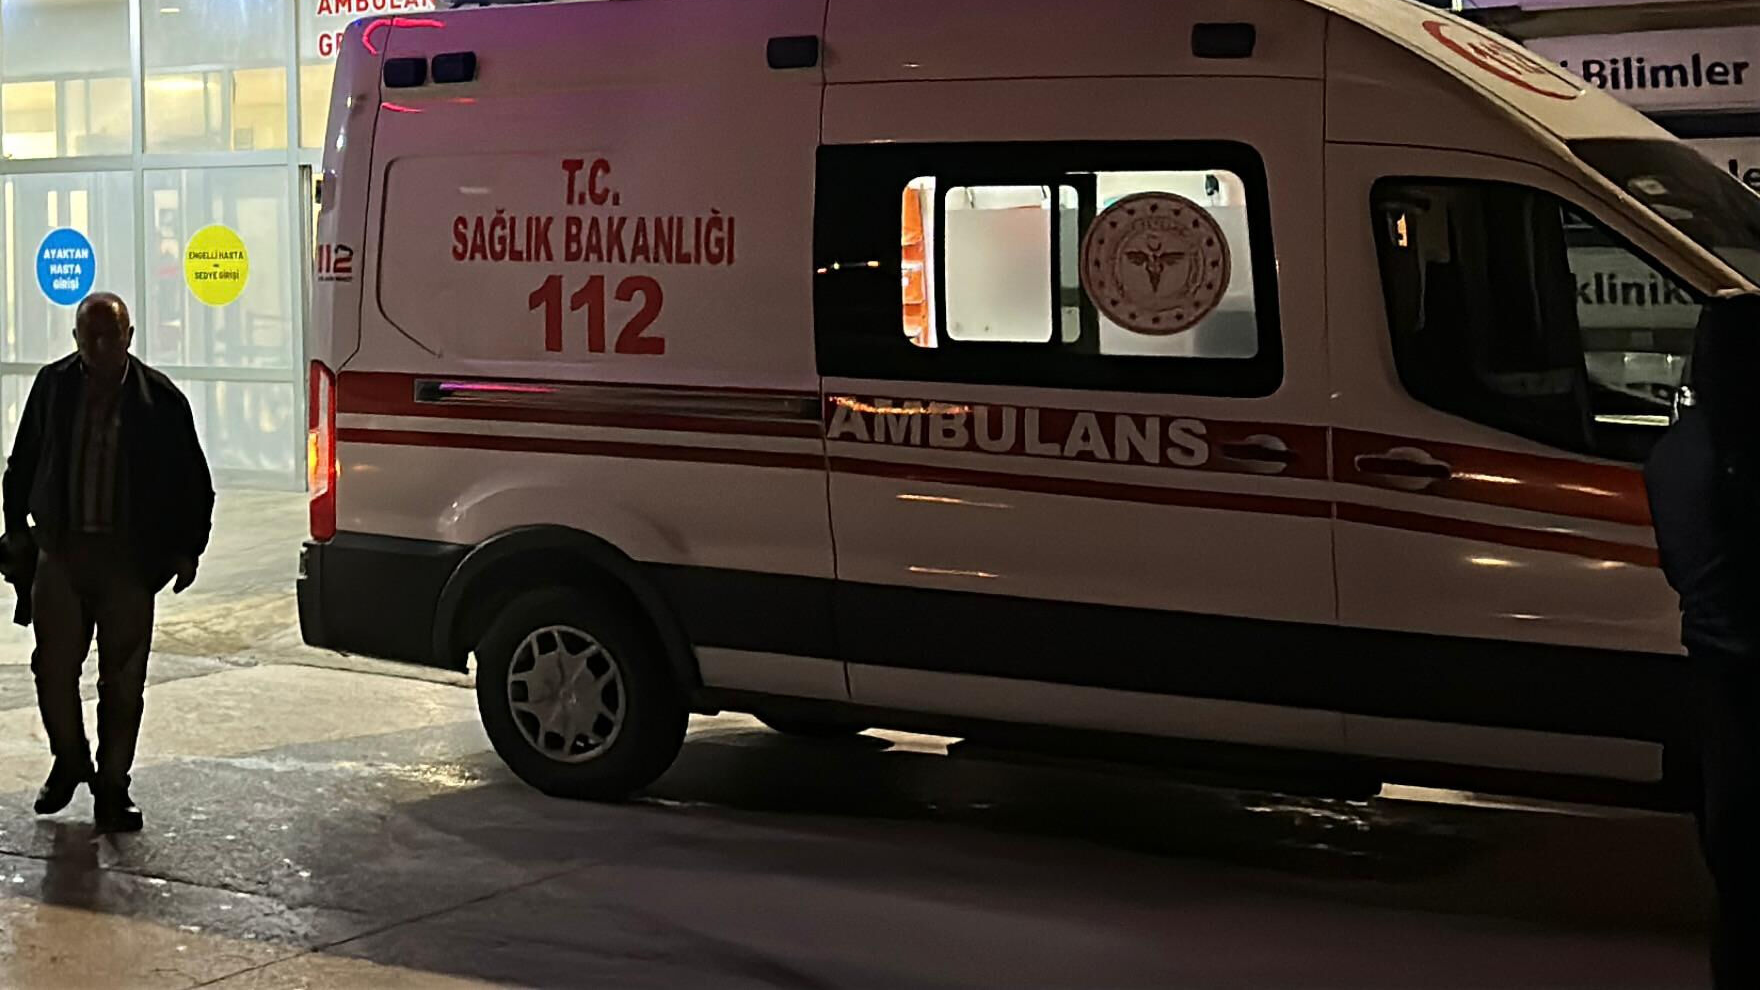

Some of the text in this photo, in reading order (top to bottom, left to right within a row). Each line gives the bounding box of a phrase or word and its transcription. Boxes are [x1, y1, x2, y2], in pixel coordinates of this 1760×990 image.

[1582, 53, 1750, 90] Bilimler
[562, 158, 621, 206] T.C.
[452, 207, 735, 265] SAĞLIK BAKANLIĞI
[528, 274, 666, 355] 112
[826, 394, 1211, 468] AMBULANS
